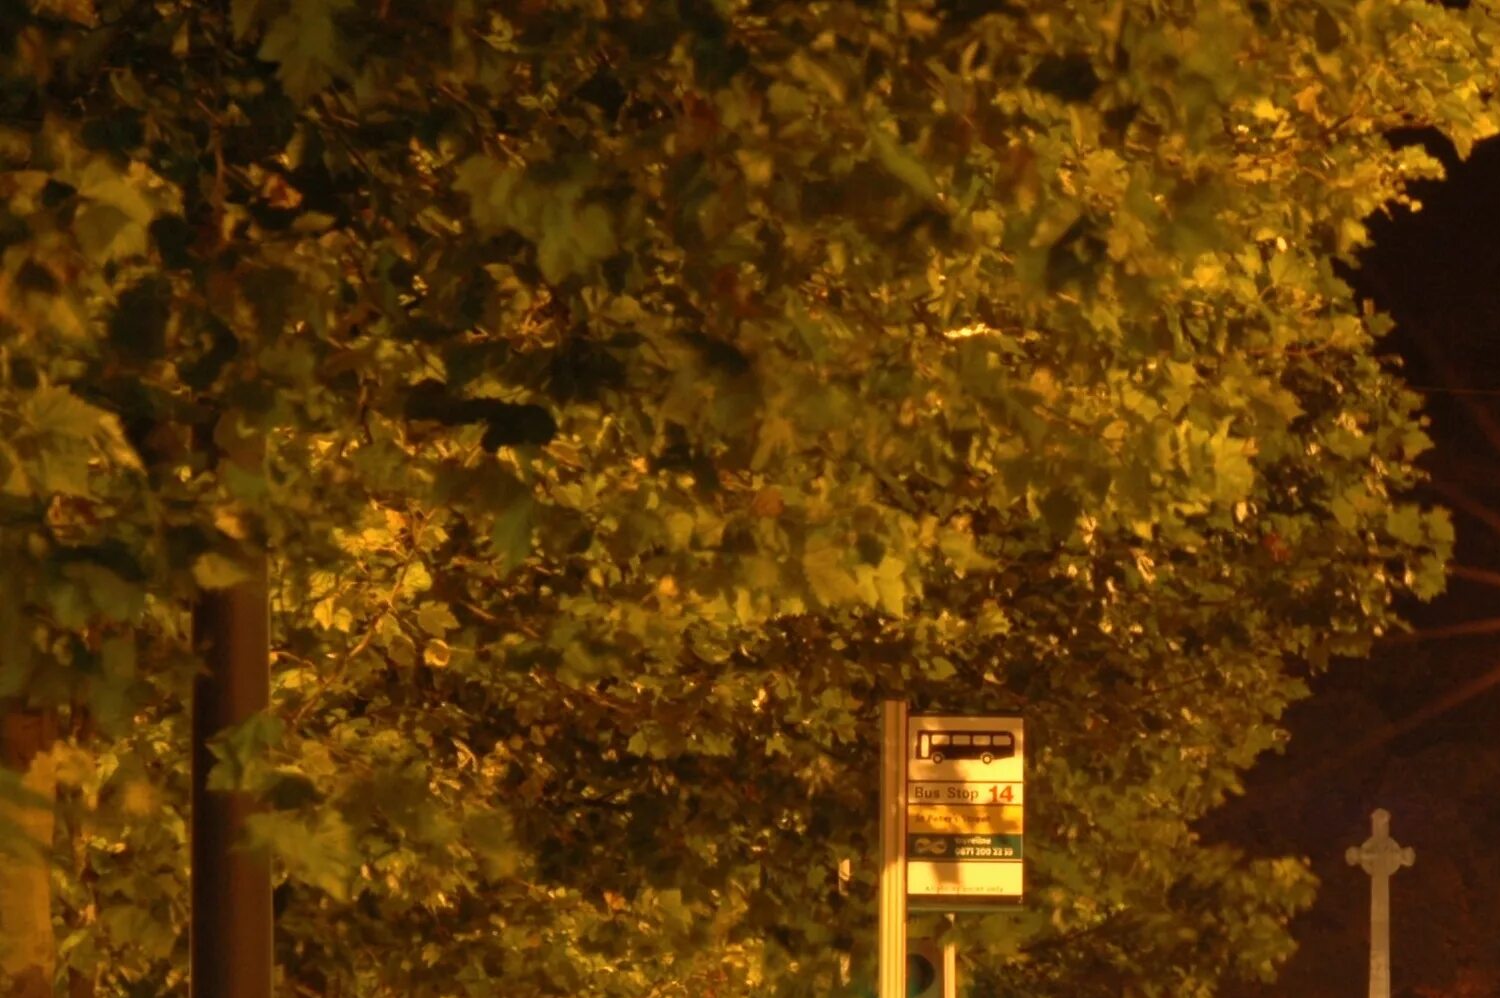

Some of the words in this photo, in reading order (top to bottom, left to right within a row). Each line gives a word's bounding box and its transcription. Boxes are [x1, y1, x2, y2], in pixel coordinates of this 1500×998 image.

[915, 787, 940, 799] Bus
[947, 787, 979, 801] Stop
[989, 785, 1014, 802] 14
